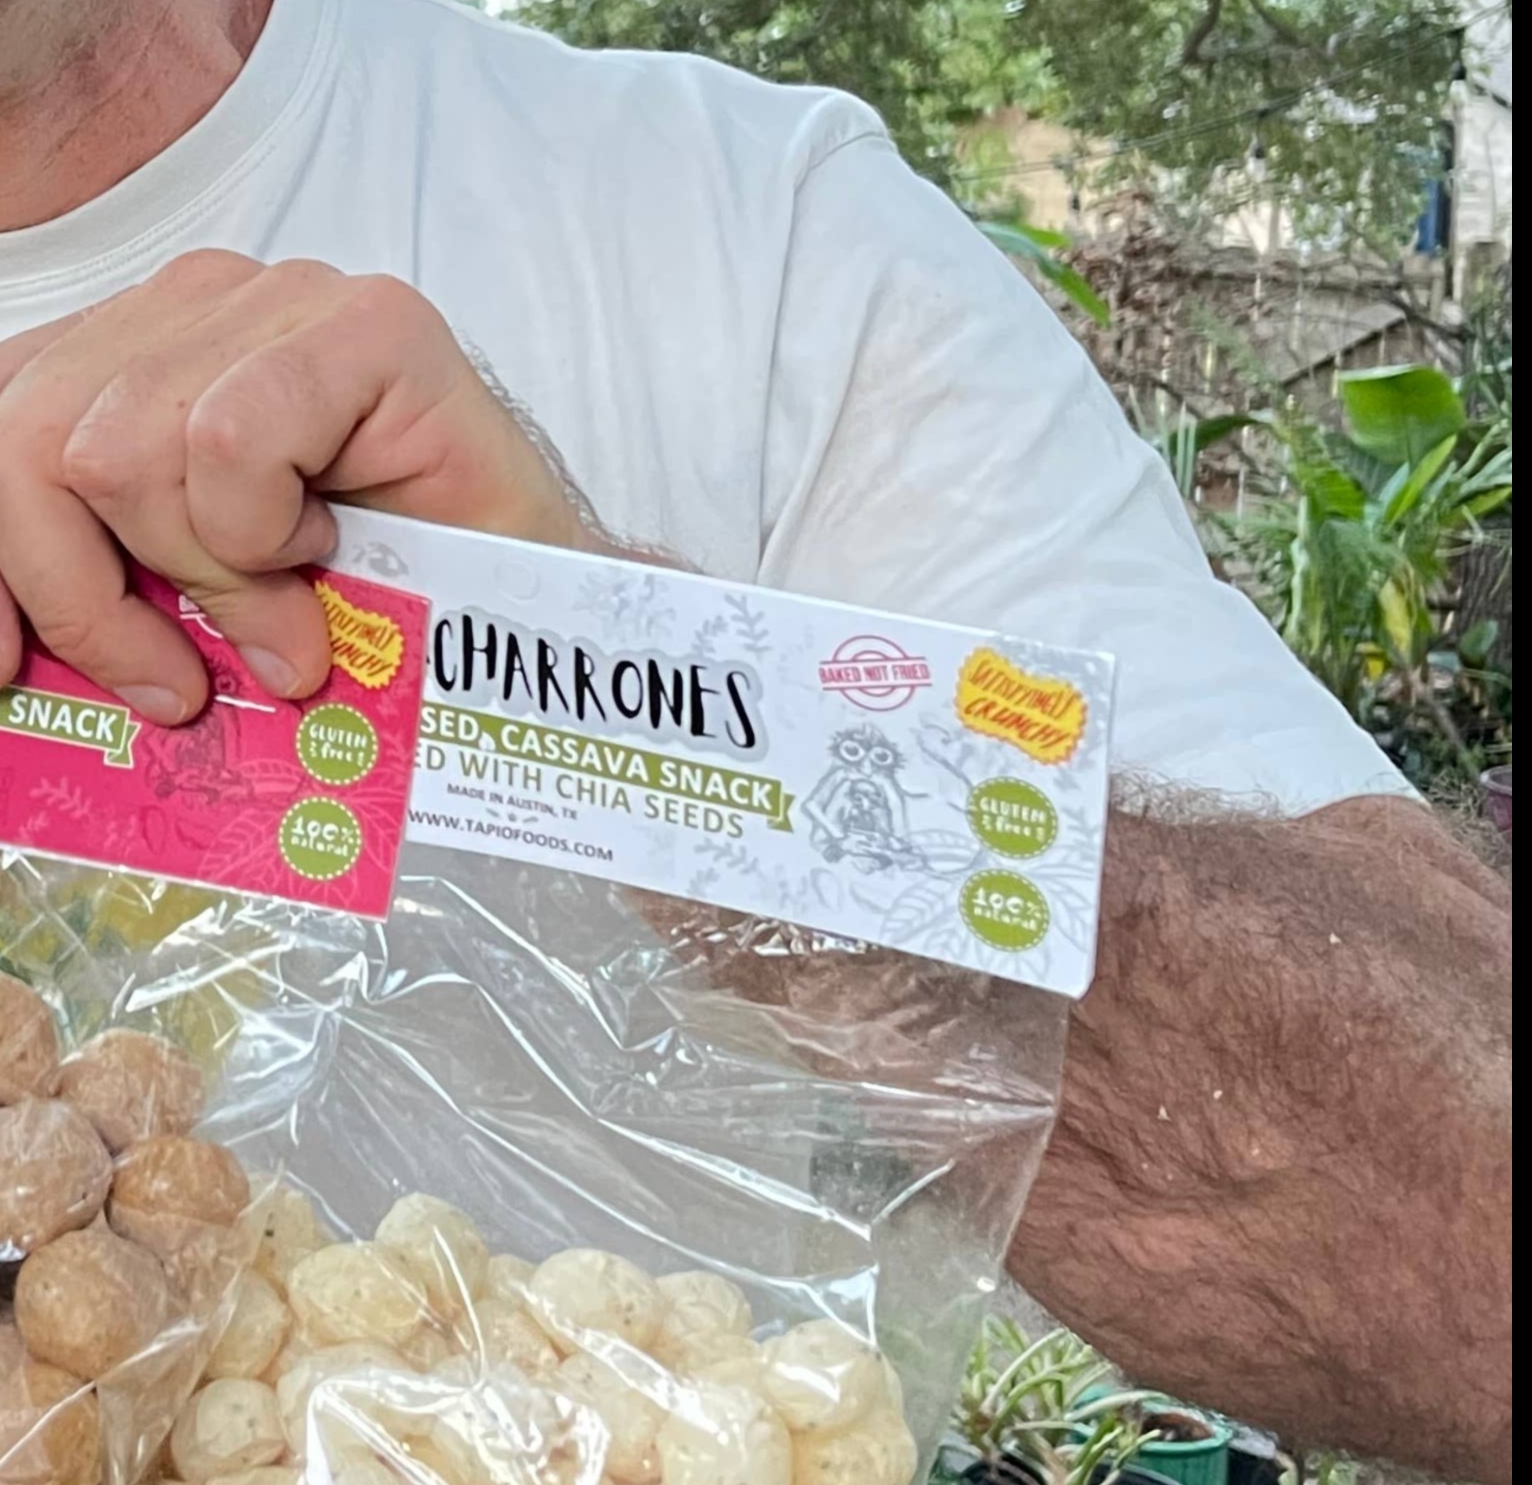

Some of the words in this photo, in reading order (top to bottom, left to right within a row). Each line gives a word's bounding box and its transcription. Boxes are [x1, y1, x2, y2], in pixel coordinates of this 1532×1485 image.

[818, 665, 862, 684] BAKED
[863, 664, 889, 682] NOT
[891, 664, 930, 681] FRIED
[8, 694, 117, 743] SNACK
[964, 697, 1070, 749] CRUNCHY
[309, 723, 367, 748] GLUTEN
[501, 724, 649, 783] CASSAVA
[660, 761, 773, 811] SNACK
[447, 783, 485, 801] MADE
[489, 789, 504, 805] IN
[506, 796, 558, 818] AUSTIN,
[561, 807, 578, 821] TX
[459, 750, 541, 792] WITH
[556, 774, 632, 814] CHIA
[644, 794, 744, 838] SEEDS
[979, 797, 1046, 824] GLUTEN
[290, 816, 355, 845] 100%
[290, 835, 349, 857] natural
[409, 810, 614, 861] WWW.TAPIOFOODS.COM
[972, 887, 1042, 918] 100%
[974, 906, 1038, 931] natural
